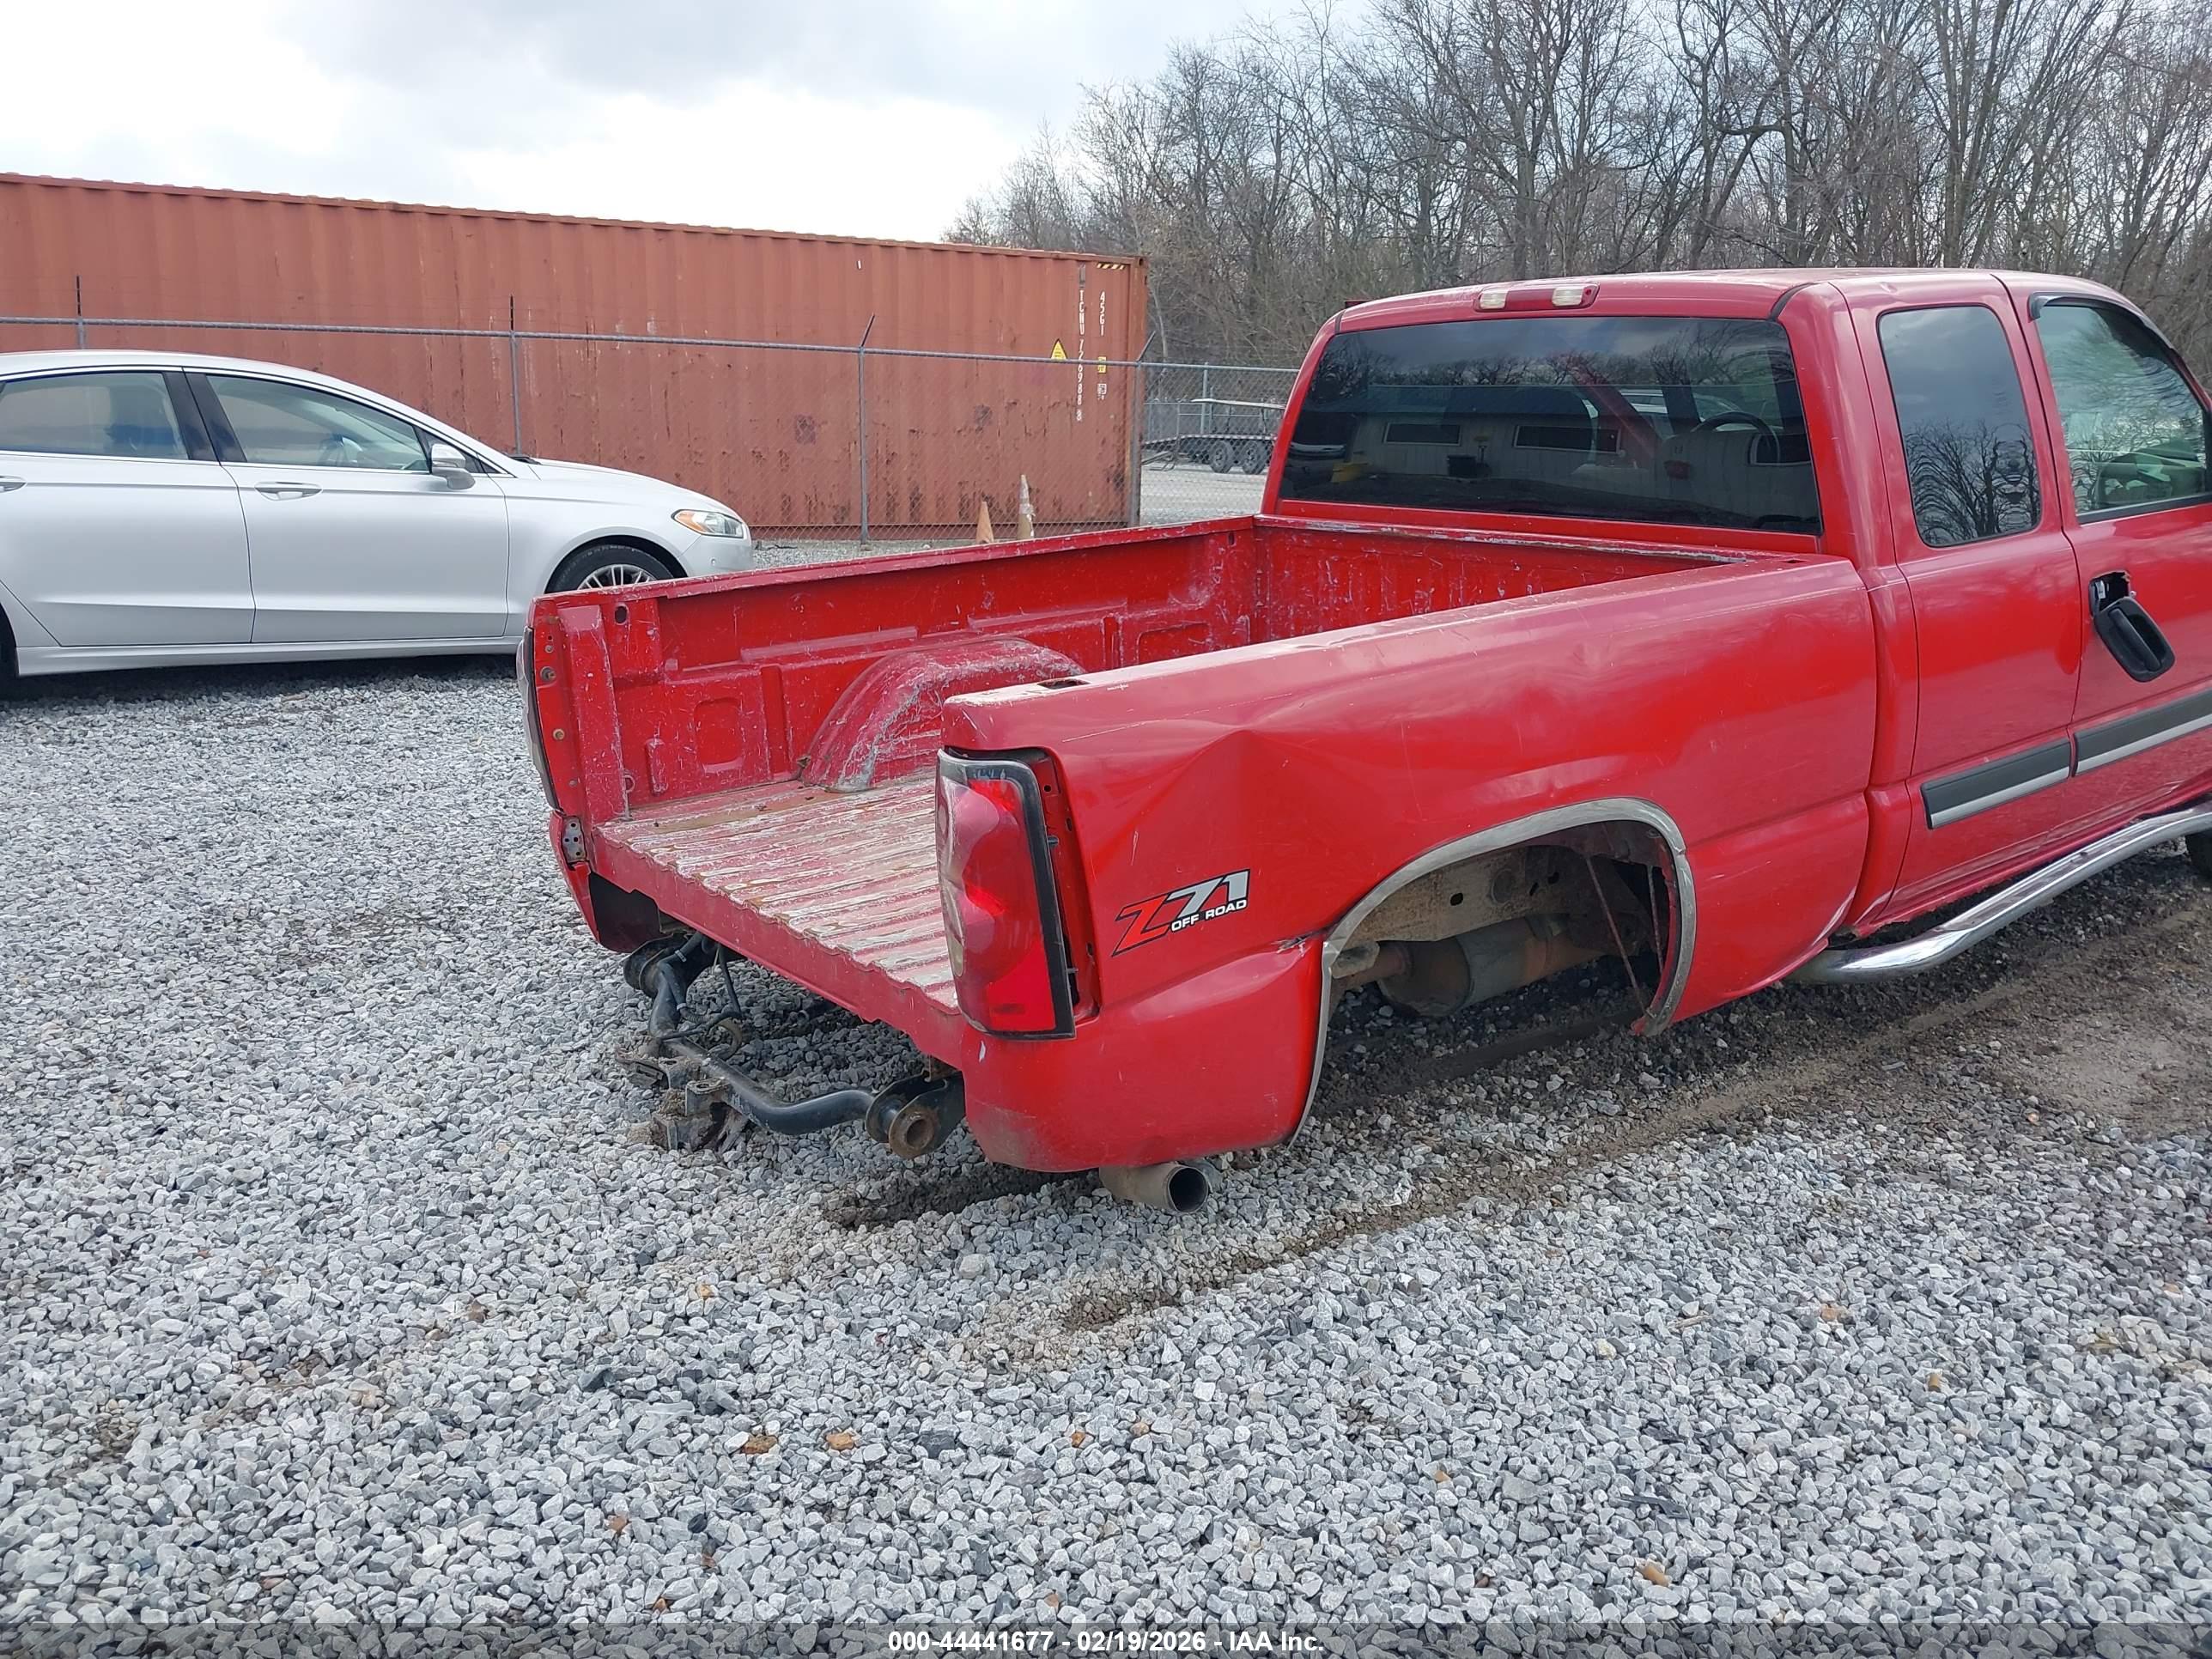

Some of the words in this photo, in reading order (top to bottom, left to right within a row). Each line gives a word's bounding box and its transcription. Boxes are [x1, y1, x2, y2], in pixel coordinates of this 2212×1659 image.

[1112, 869, 1250, 957] Z71
[1170, 914, 1200, 933] OFF
[1205, 899, 1248, 921] ROAD
